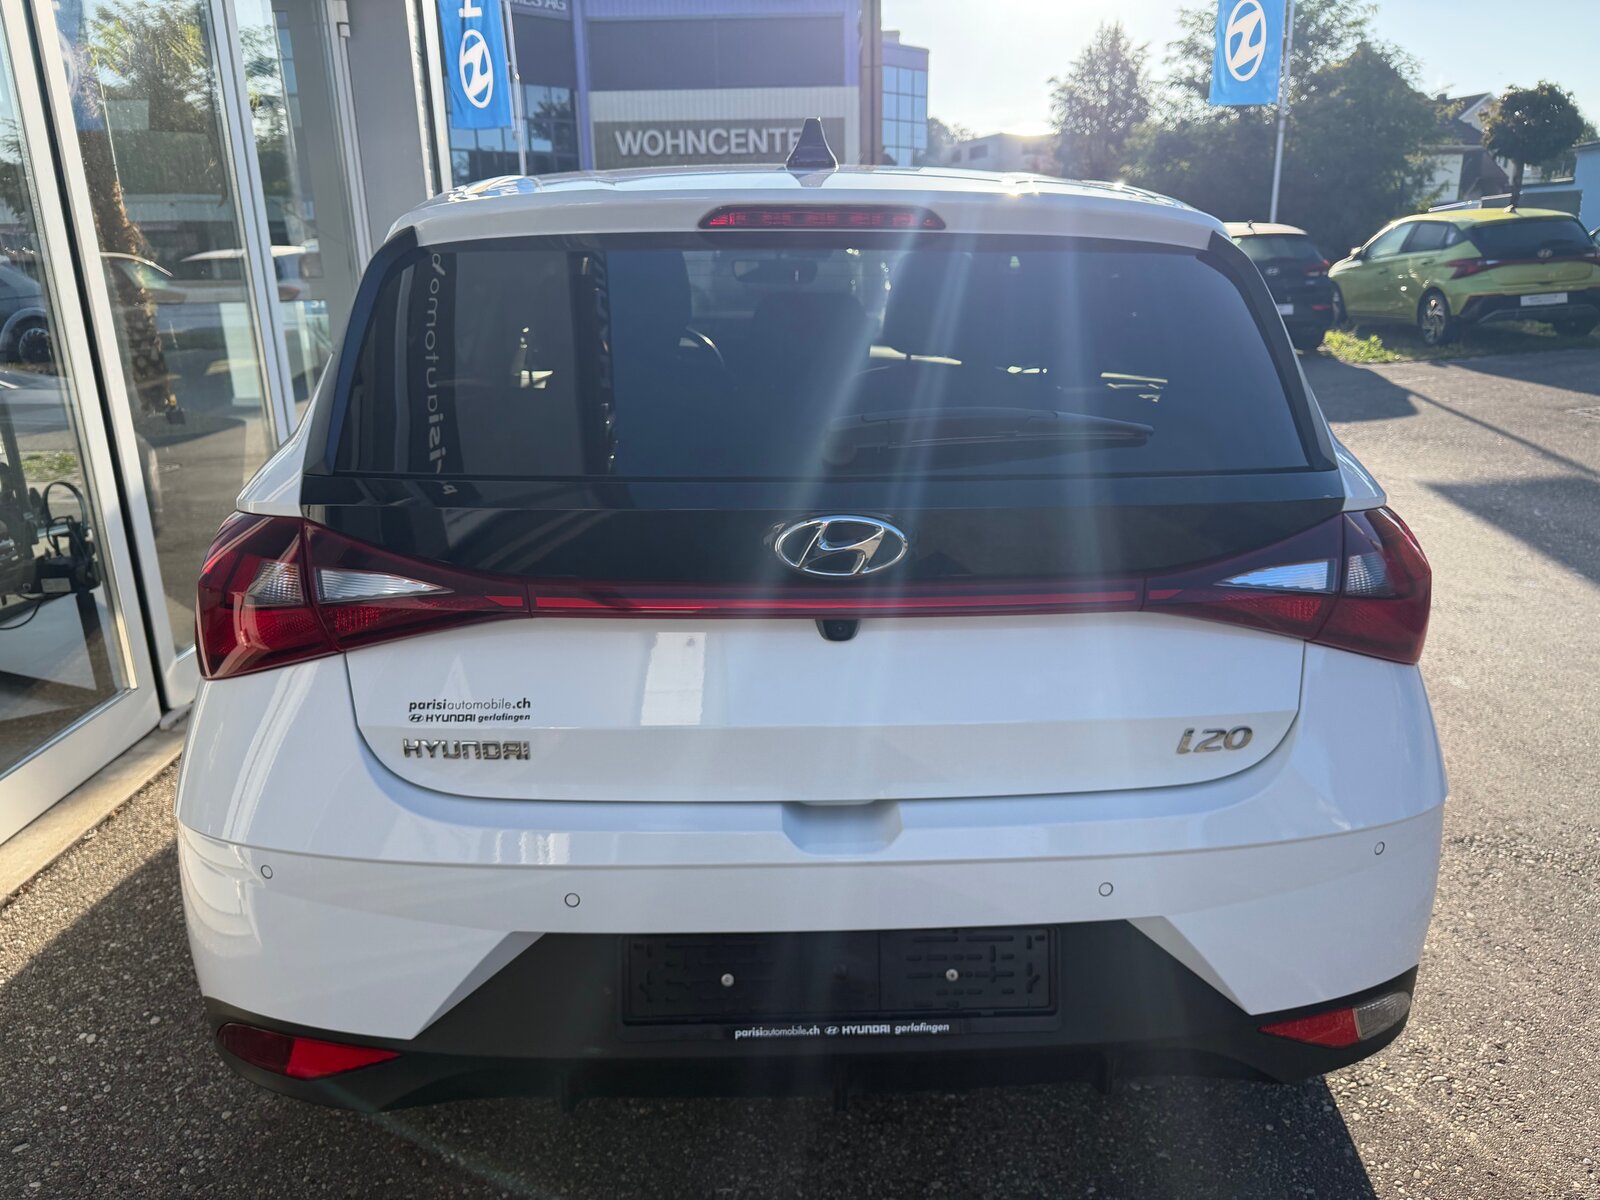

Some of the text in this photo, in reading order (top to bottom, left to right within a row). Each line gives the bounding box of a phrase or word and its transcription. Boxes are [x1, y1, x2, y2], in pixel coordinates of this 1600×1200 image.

[615, 128, 802, 156] WOHNCENTE
[408, 697, 531, 712] parisiautomobile.ch
[425, 713, 531, 723] HYUNDAI gerlafingen
[403, 738, 531, 760] HYUNDAI
[1176, 725, 1253, 755] i20
[734, 1022, 950, 1040] parisiautomobile.ch HYUNDAI gerlafingen
